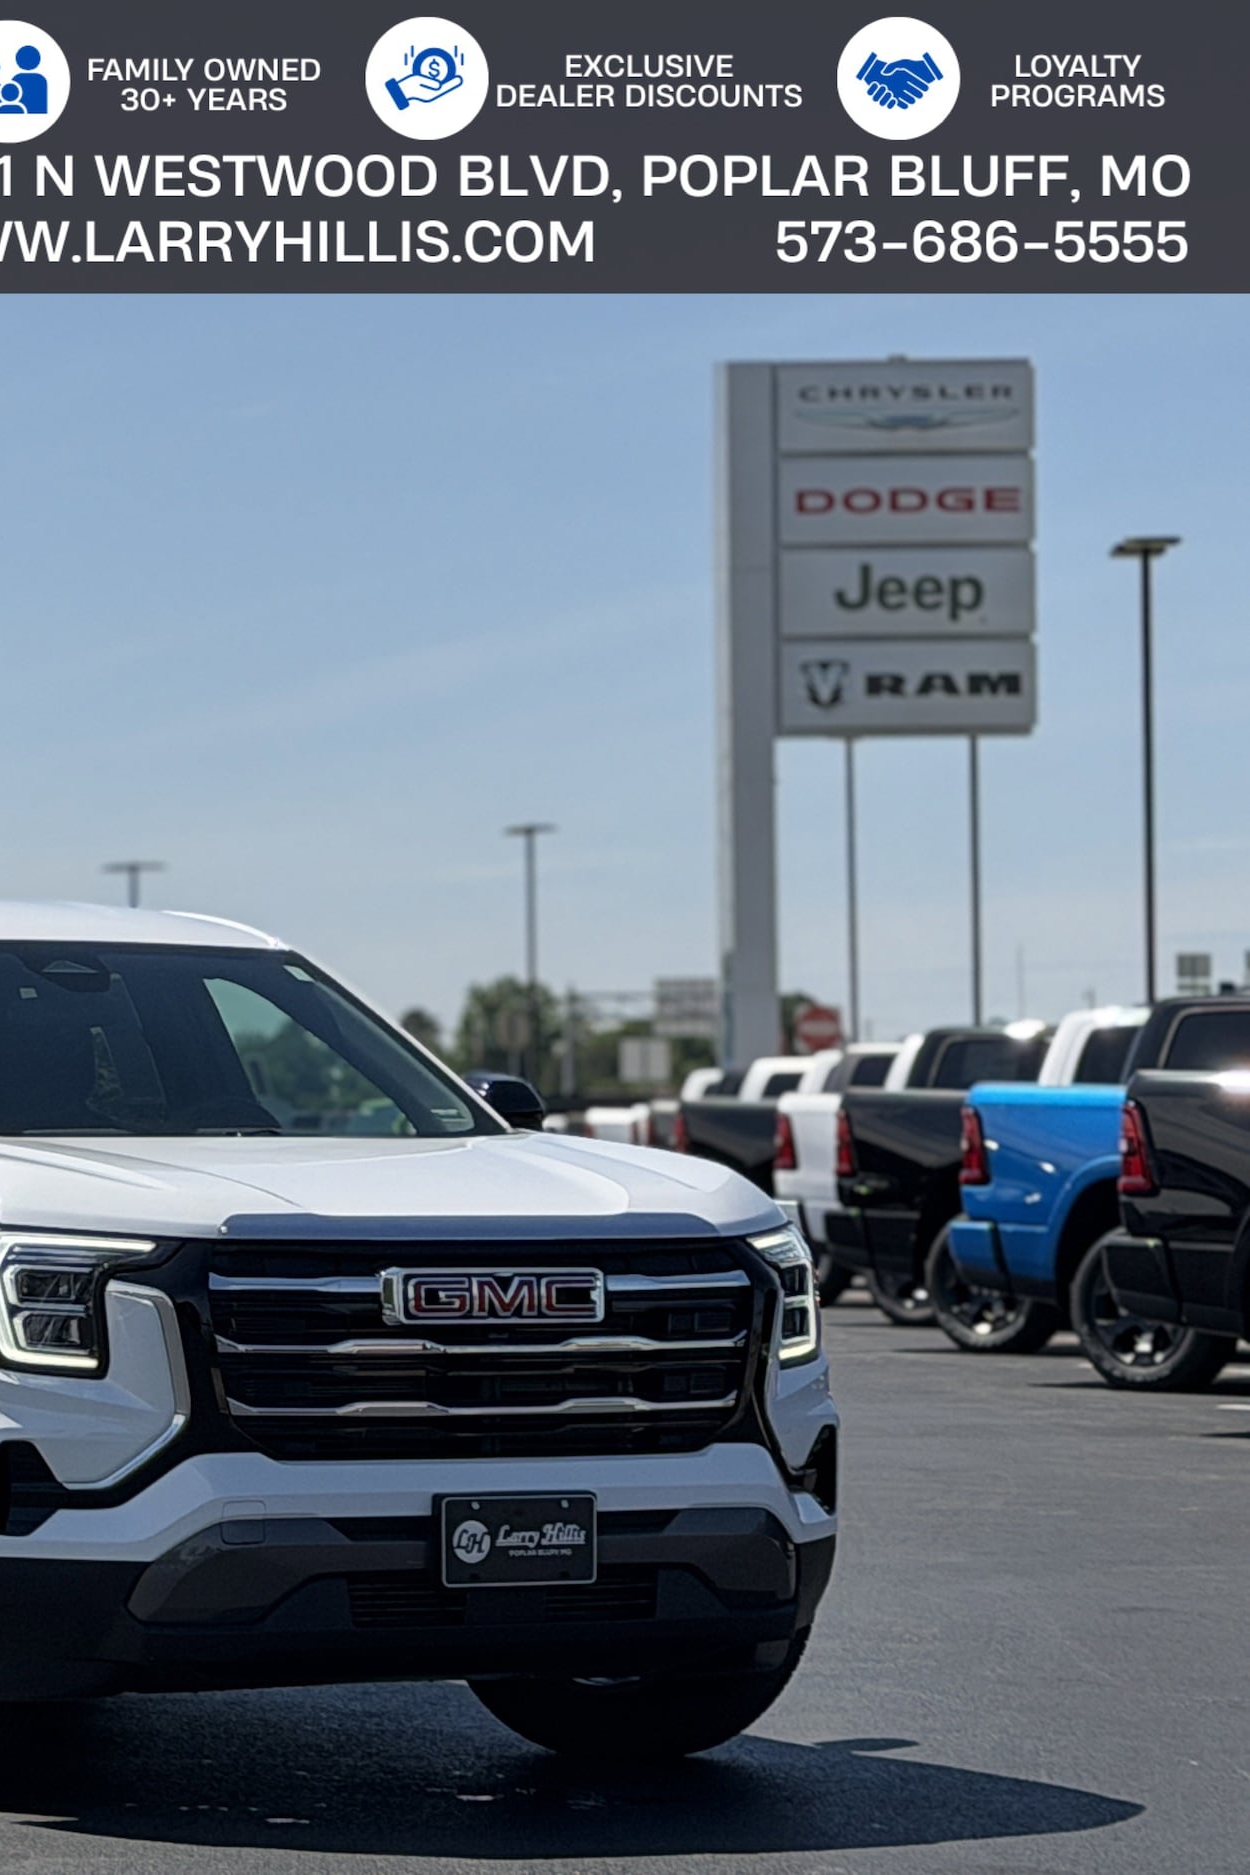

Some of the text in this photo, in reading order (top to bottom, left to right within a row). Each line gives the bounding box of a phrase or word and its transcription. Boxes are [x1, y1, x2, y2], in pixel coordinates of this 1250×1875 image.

[798, 384, 1014, 402] CHRYSLER
[794, 487, 1021, 515] DODGE
[834, 563, 984, 622] Jeep
[865, 672, 1022, 697] RAM
[407, 1276, 599, 1317] GMC
[495, 1521, 586, 1548] Larry Hillis
